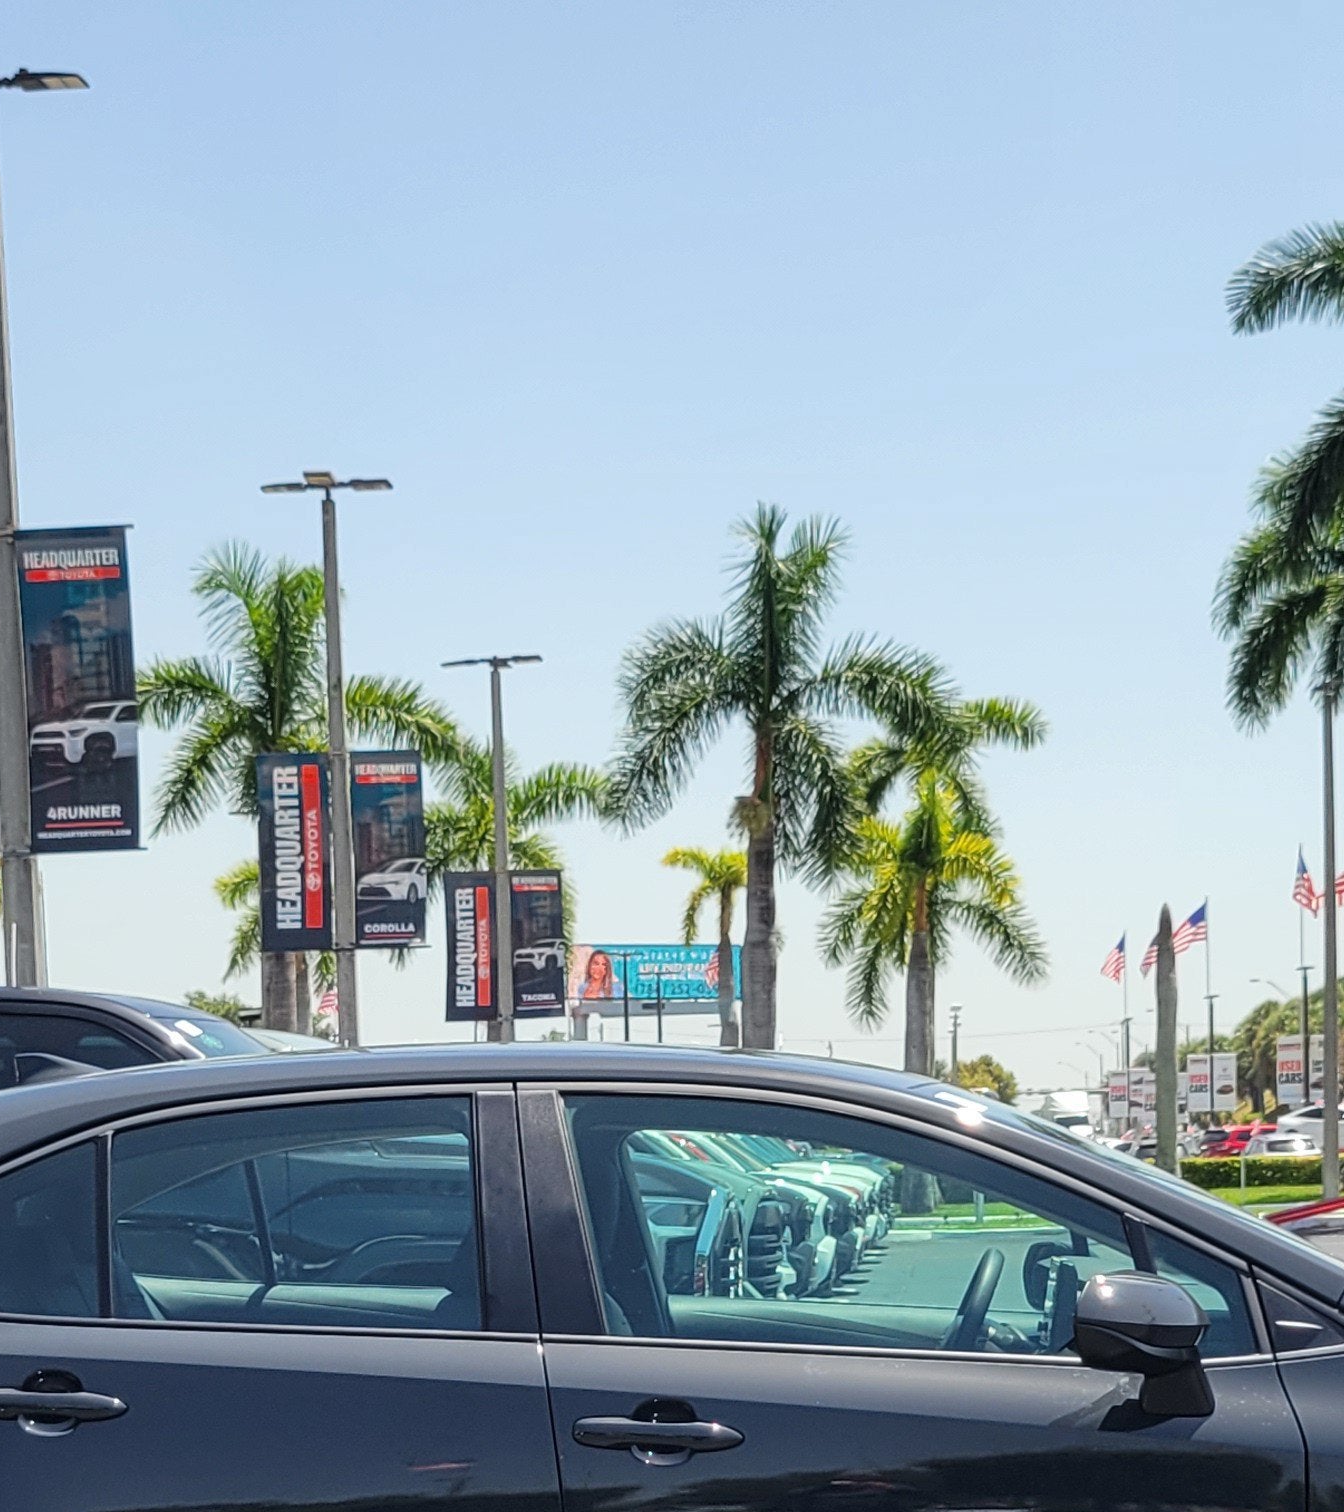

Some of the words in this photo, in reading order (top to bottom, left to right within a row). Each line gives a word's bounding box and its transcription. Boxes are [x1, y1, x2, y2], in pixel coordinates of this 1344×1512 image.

[23, 548, 120, 570] HEADQUARTER
[60, 568, 97, 580] TOYOTA
[47, 804, 122, 820] 4RUNNER
[307, 809, 319, 870] TOYOTA
[273, 766, 305, 930] HEADQUARTER
[364, 923, 416, 933] COROLLA
[455, 887, 477, 1007] HEADQUARTER
[1279, 1073, 1303, 1084] CARS
[1189, 1084, 1208, 1093] CARS
